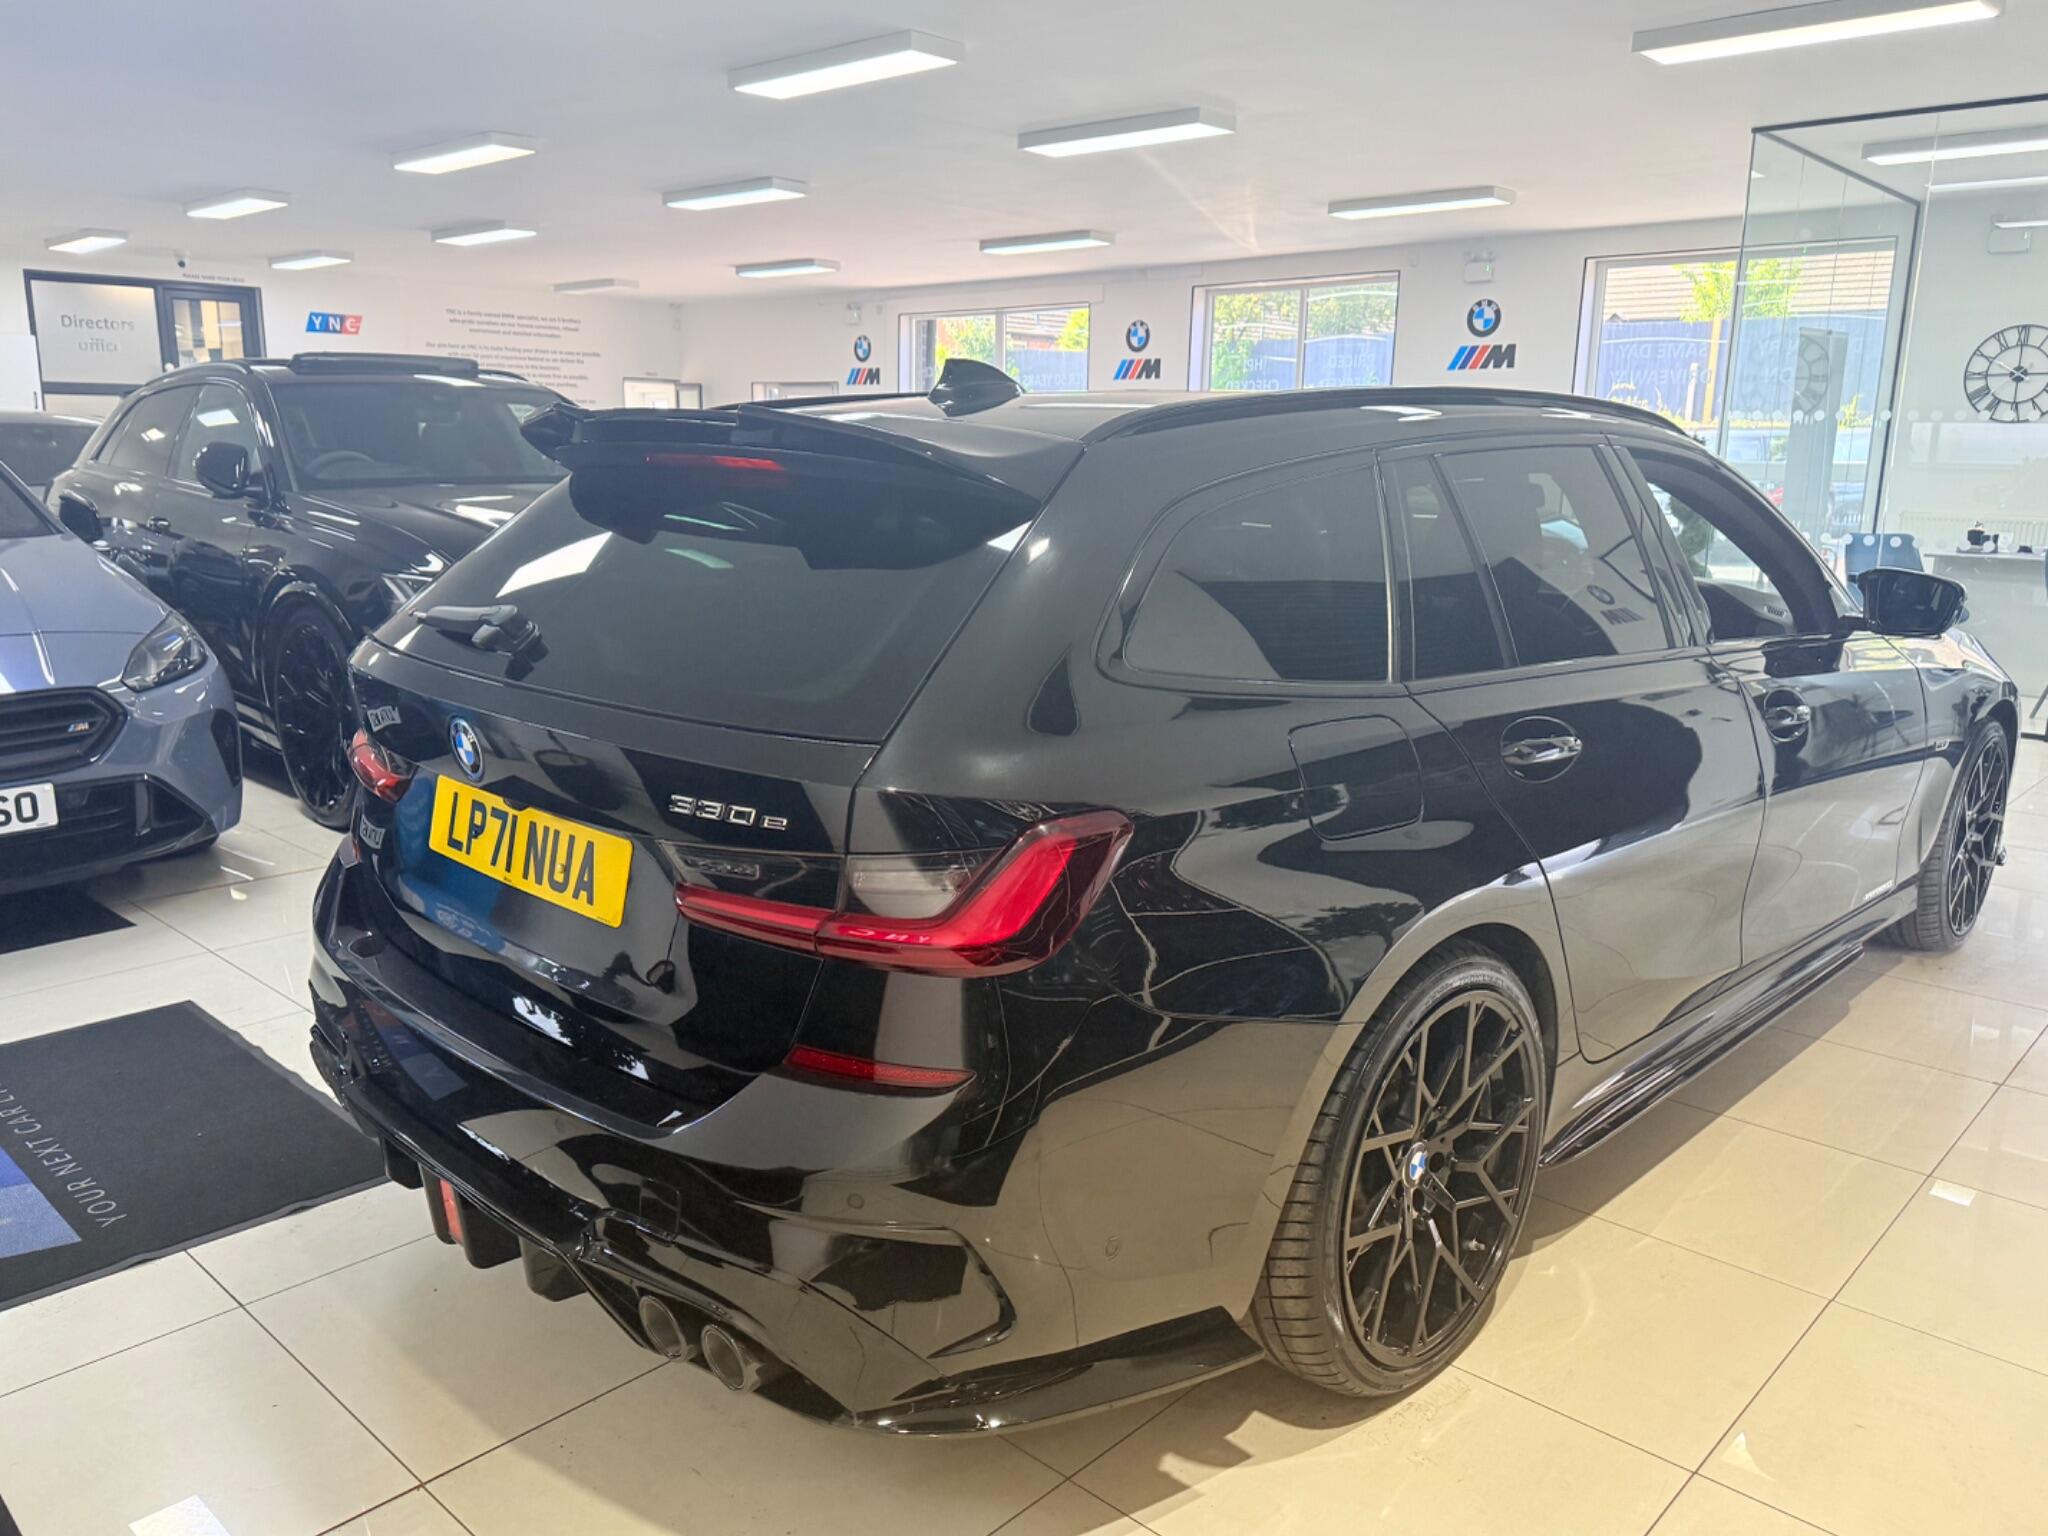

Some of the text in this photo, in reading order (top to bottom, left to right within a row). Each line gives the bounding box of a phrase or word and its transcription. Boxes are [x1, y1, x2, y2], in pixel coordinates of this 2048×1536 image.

[60, 314, 135, 332] Directors
[311, 315, 357, 332] YNC
[447, 791, 518, 874] LP71
[522, 820, 595, 906] NUA
[0, 1104, 128, 1228] YOUR NEXT CAR
